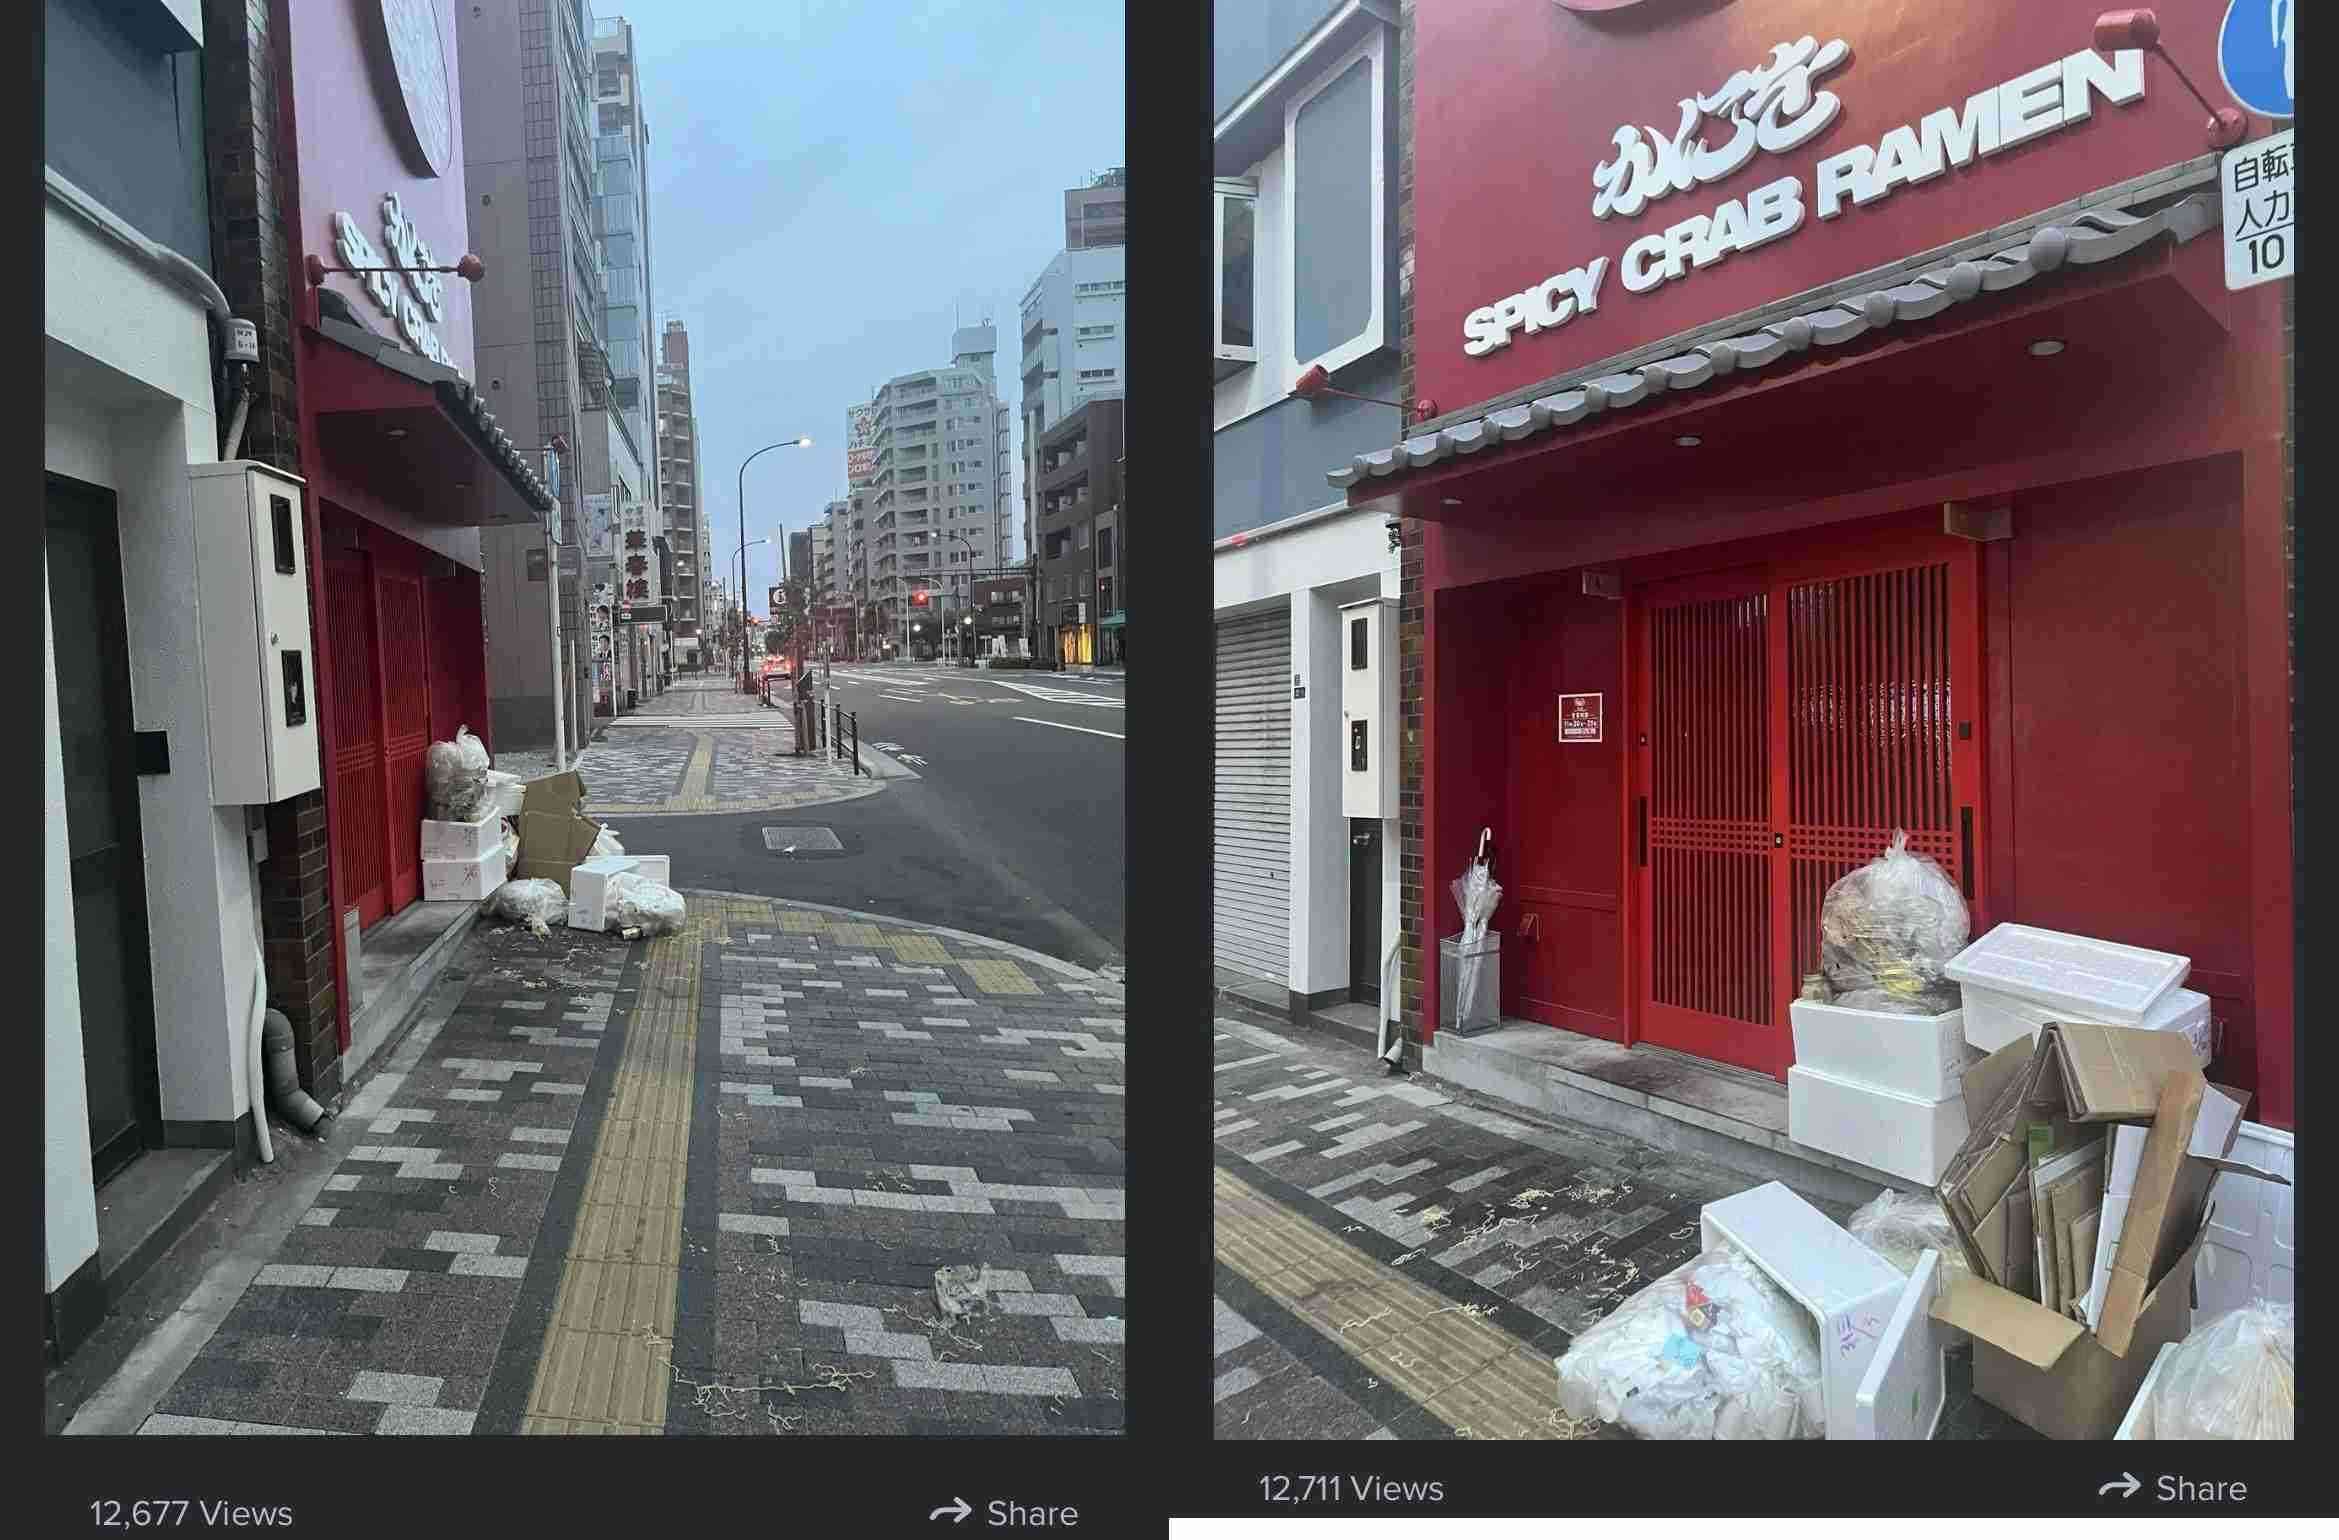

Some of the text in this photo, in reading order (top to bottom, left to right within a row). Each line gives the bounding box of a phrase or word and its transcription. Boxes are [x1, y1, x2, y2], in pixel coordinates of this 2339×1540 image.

[2234, 142, 2295, 193] 自転
[1463, 47, 2147, 357] SPICY CRAB RAMEN
[2248, 233, 2286, 275] 10
